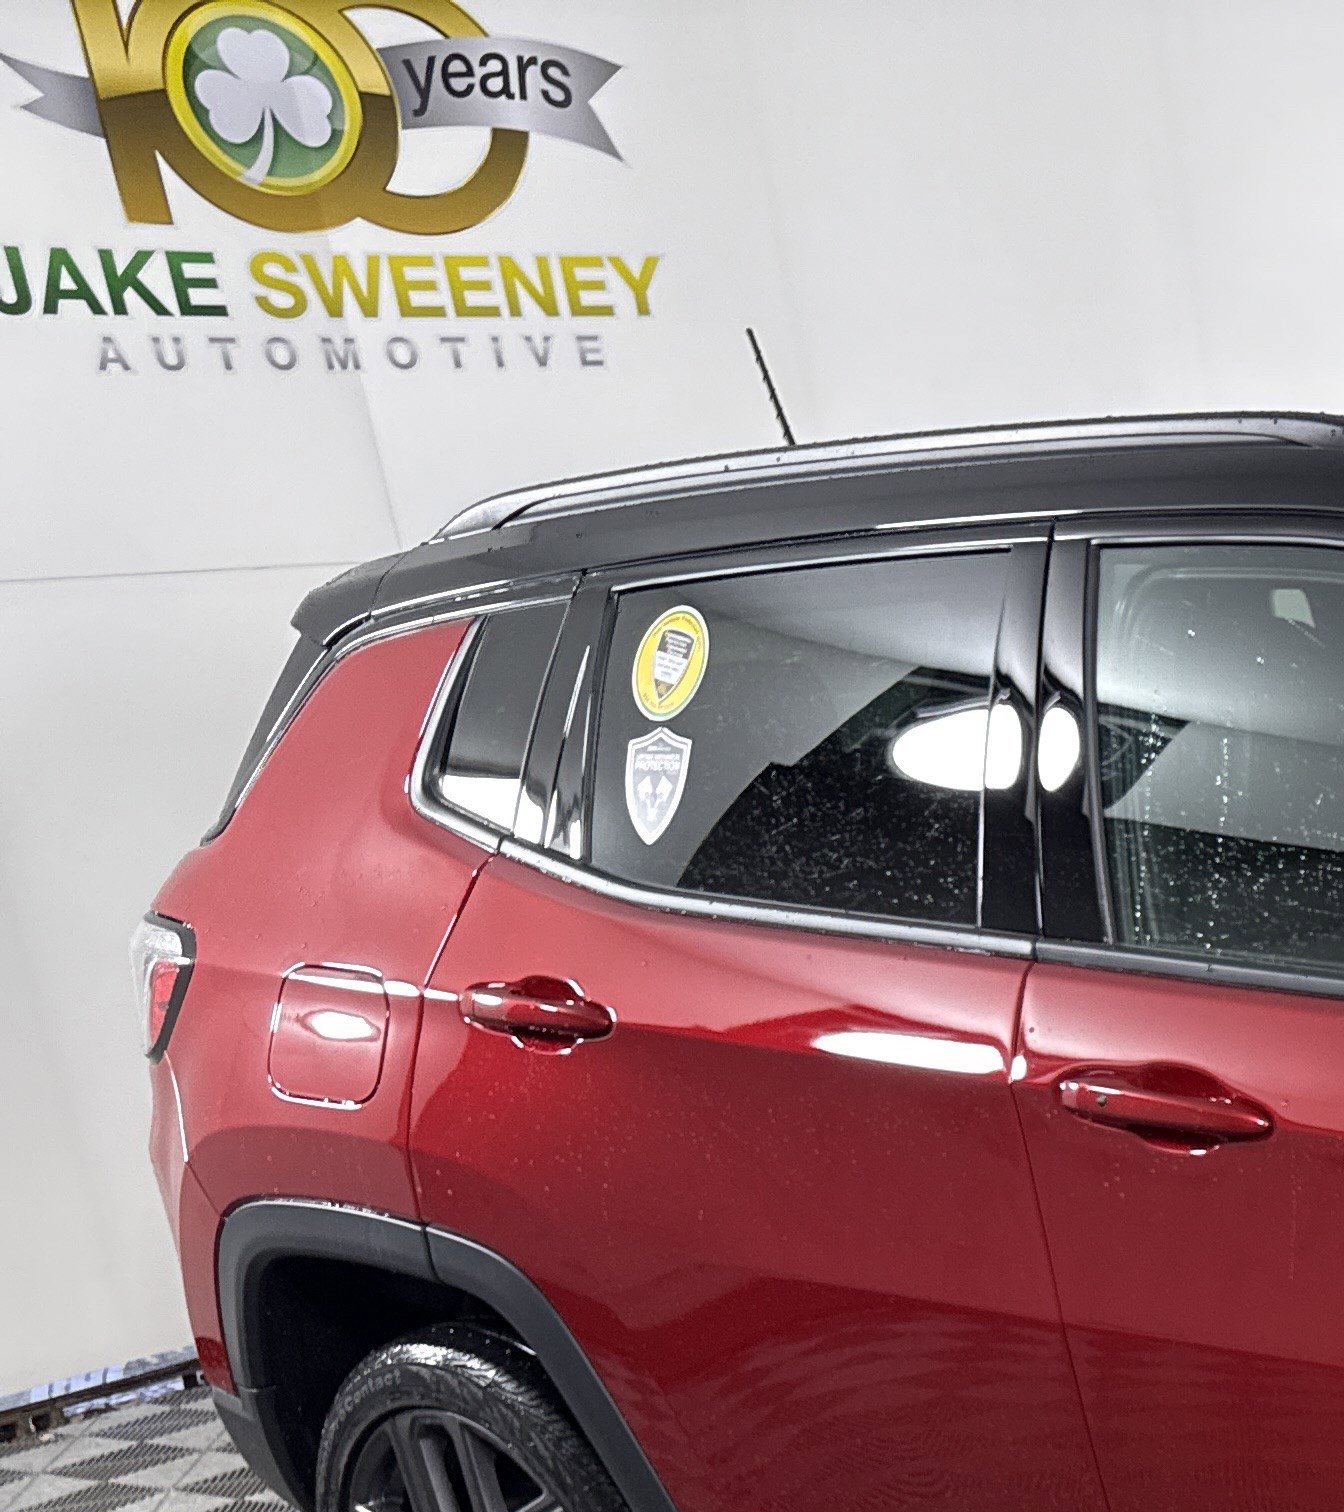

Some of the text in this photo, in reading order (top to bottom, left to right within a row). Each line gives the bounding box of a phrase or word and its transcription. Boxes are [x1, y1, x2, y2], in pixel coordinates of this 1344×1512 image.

[402, 50, 573, 117] years
[0, 245, 660, 319] JAKE SWEENEY
[99, 336, 607, 372] AUTOMOTIVE
